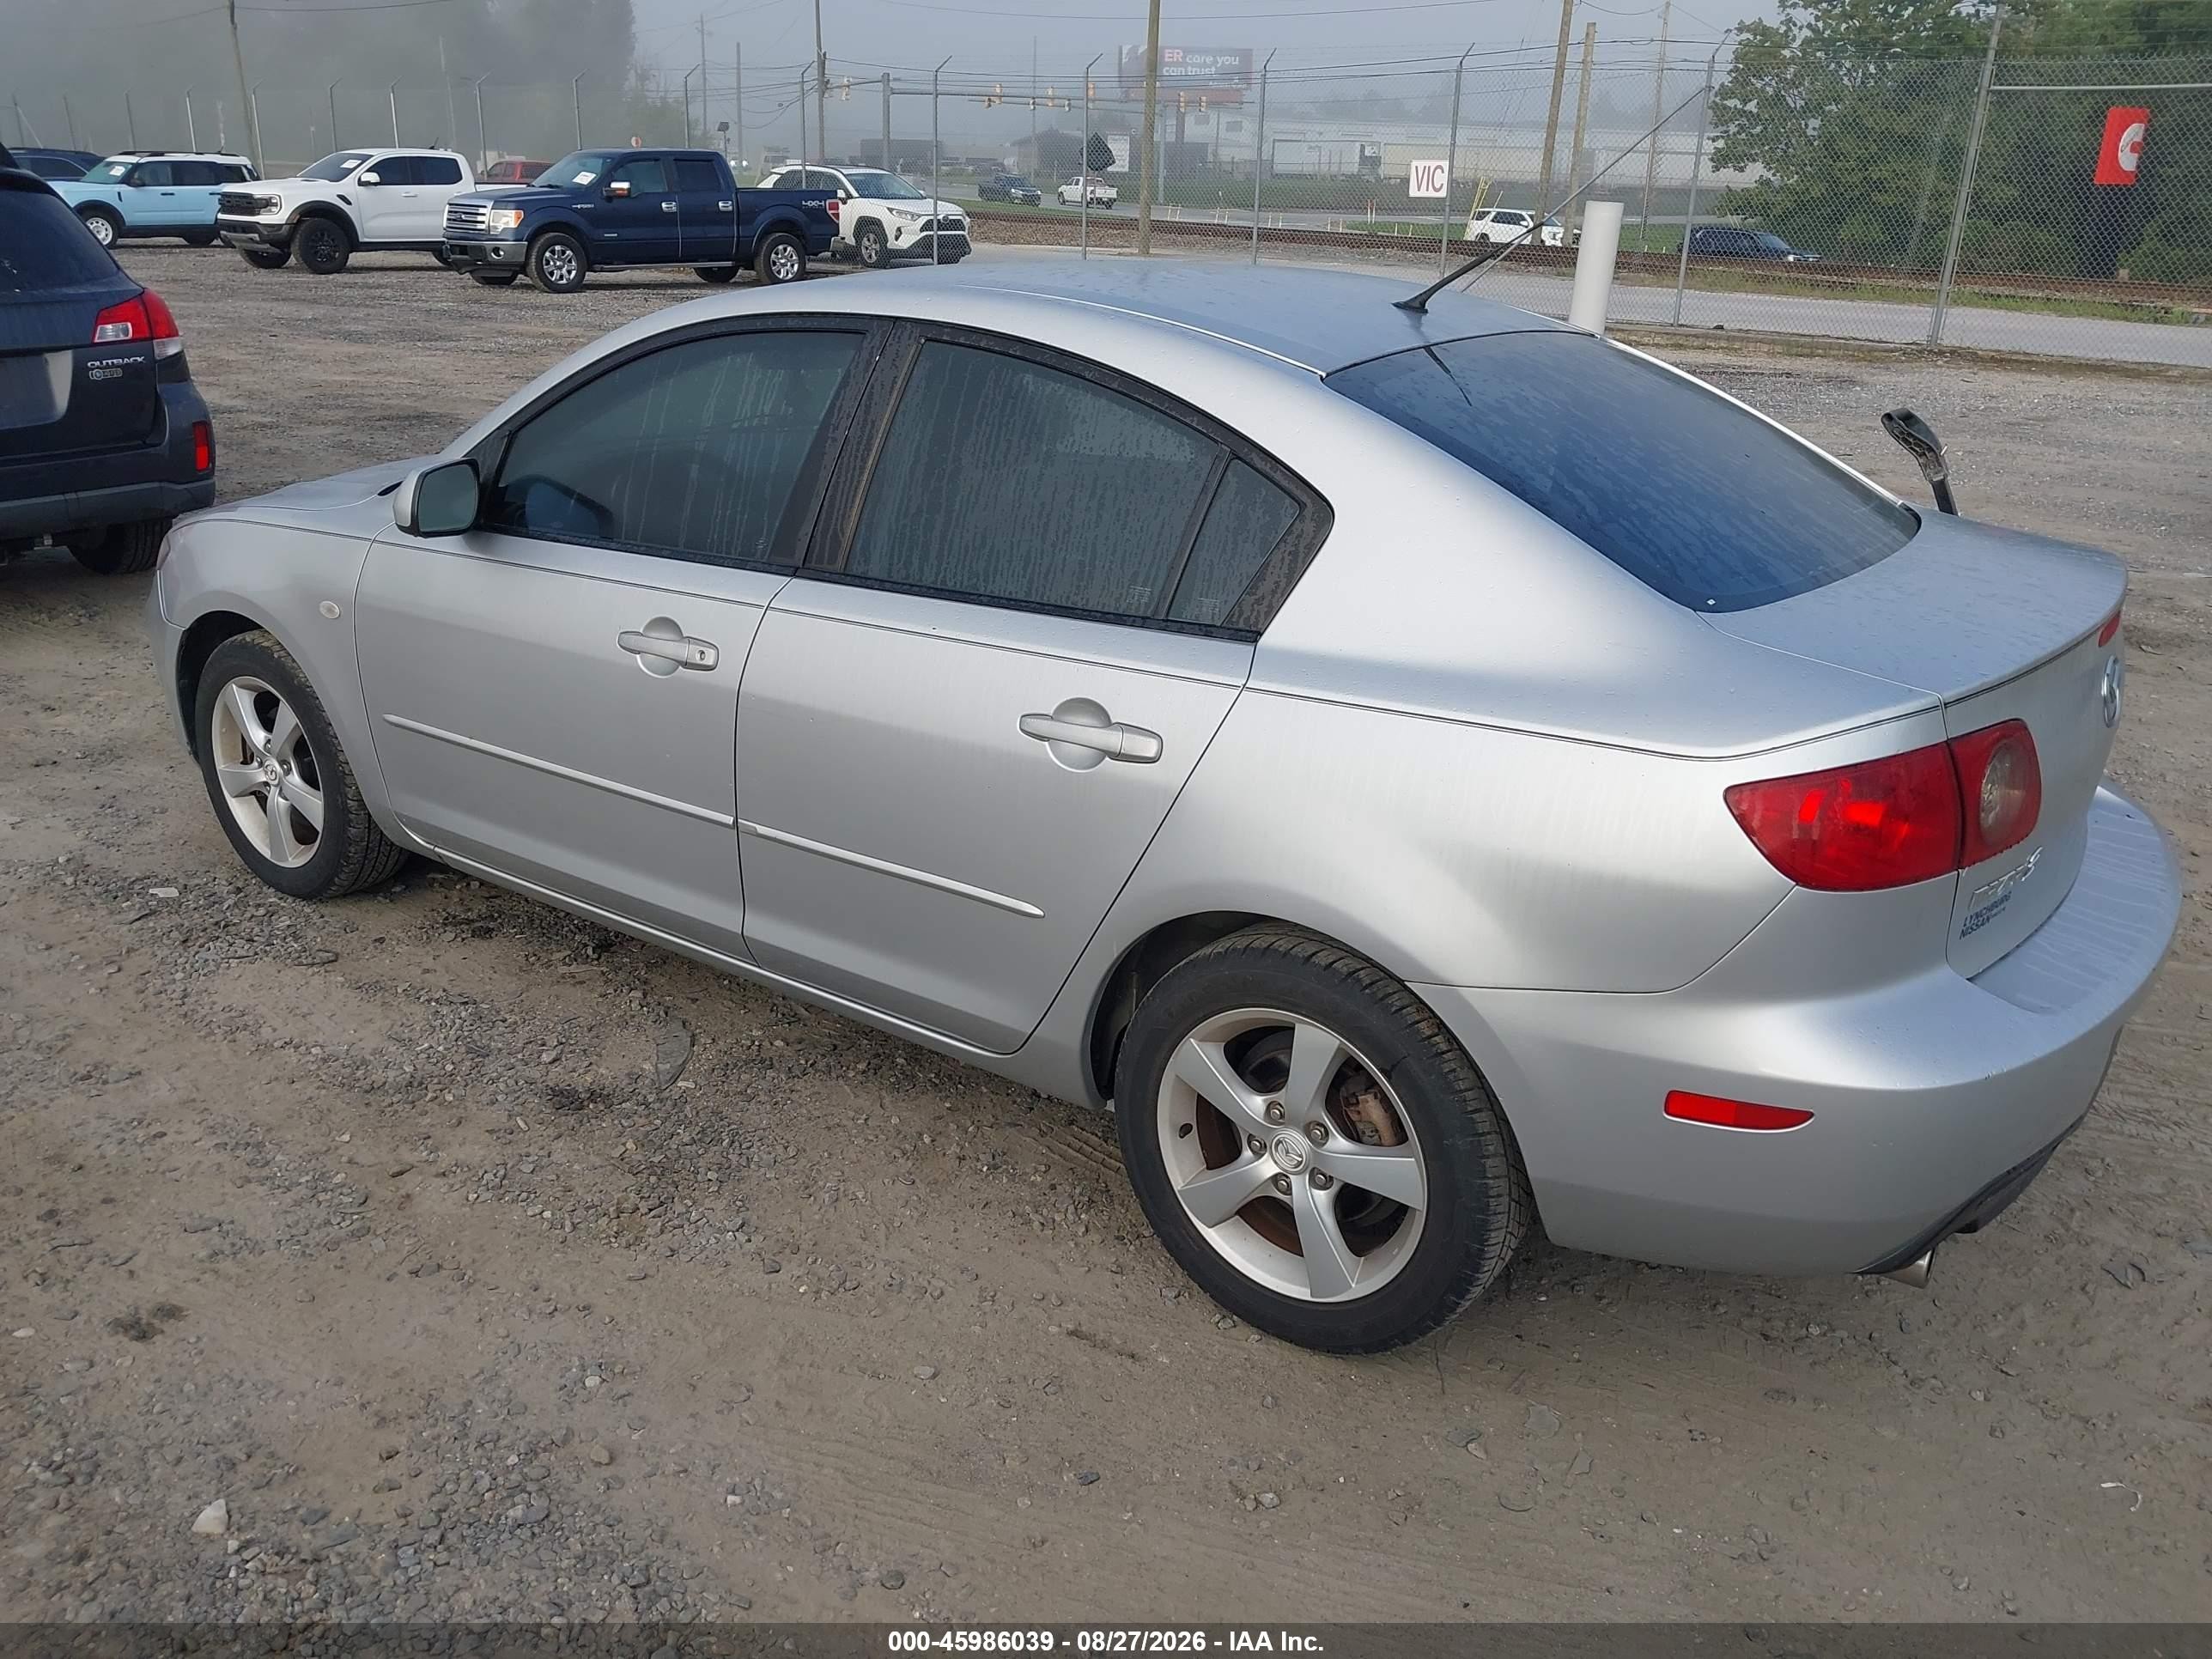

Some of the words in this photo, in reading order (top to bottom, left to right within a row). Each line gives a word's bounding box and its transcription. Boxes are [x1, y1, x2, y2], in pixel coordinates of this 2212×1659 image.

[1164, 49, 1183, 63] ER
[1186, 54, 1214, 64] care
[1216, 56, 1239, 67] you
[1163, 66, 1185, 76] can
[1187, 65, 1217, 77] trust
[1415, 164, 1444, 193] VIC
[87, 356, 145, 368] OUTBACK
[1959, 915, 1991, 941] NISSAN
